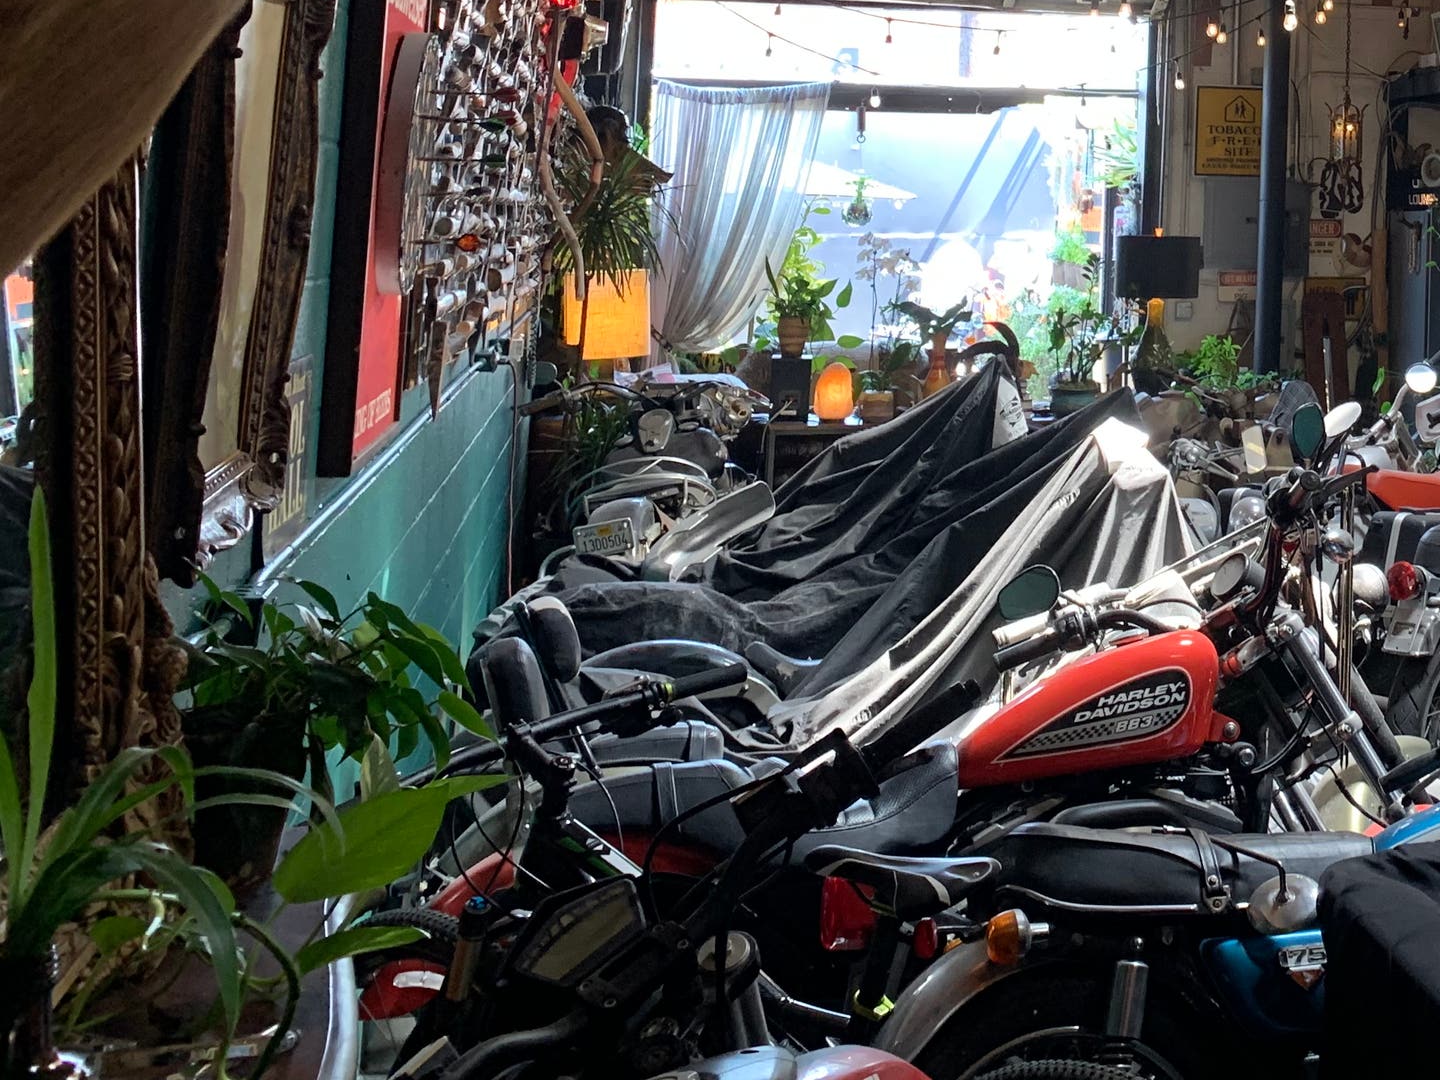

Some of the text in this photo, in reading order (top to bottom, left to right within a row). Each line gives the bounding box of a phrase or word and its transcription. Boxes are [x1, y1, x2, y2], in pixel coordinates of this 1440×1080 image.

[1208, 125, 1261, 135] TOBACC
[1312, 223, 1335, 235] NGER
[290, 400, 305, 458] OL
[1074, 691, 1185, 722] DAVIDSON
[1098, 681, 1185, 707] HARLEY-
